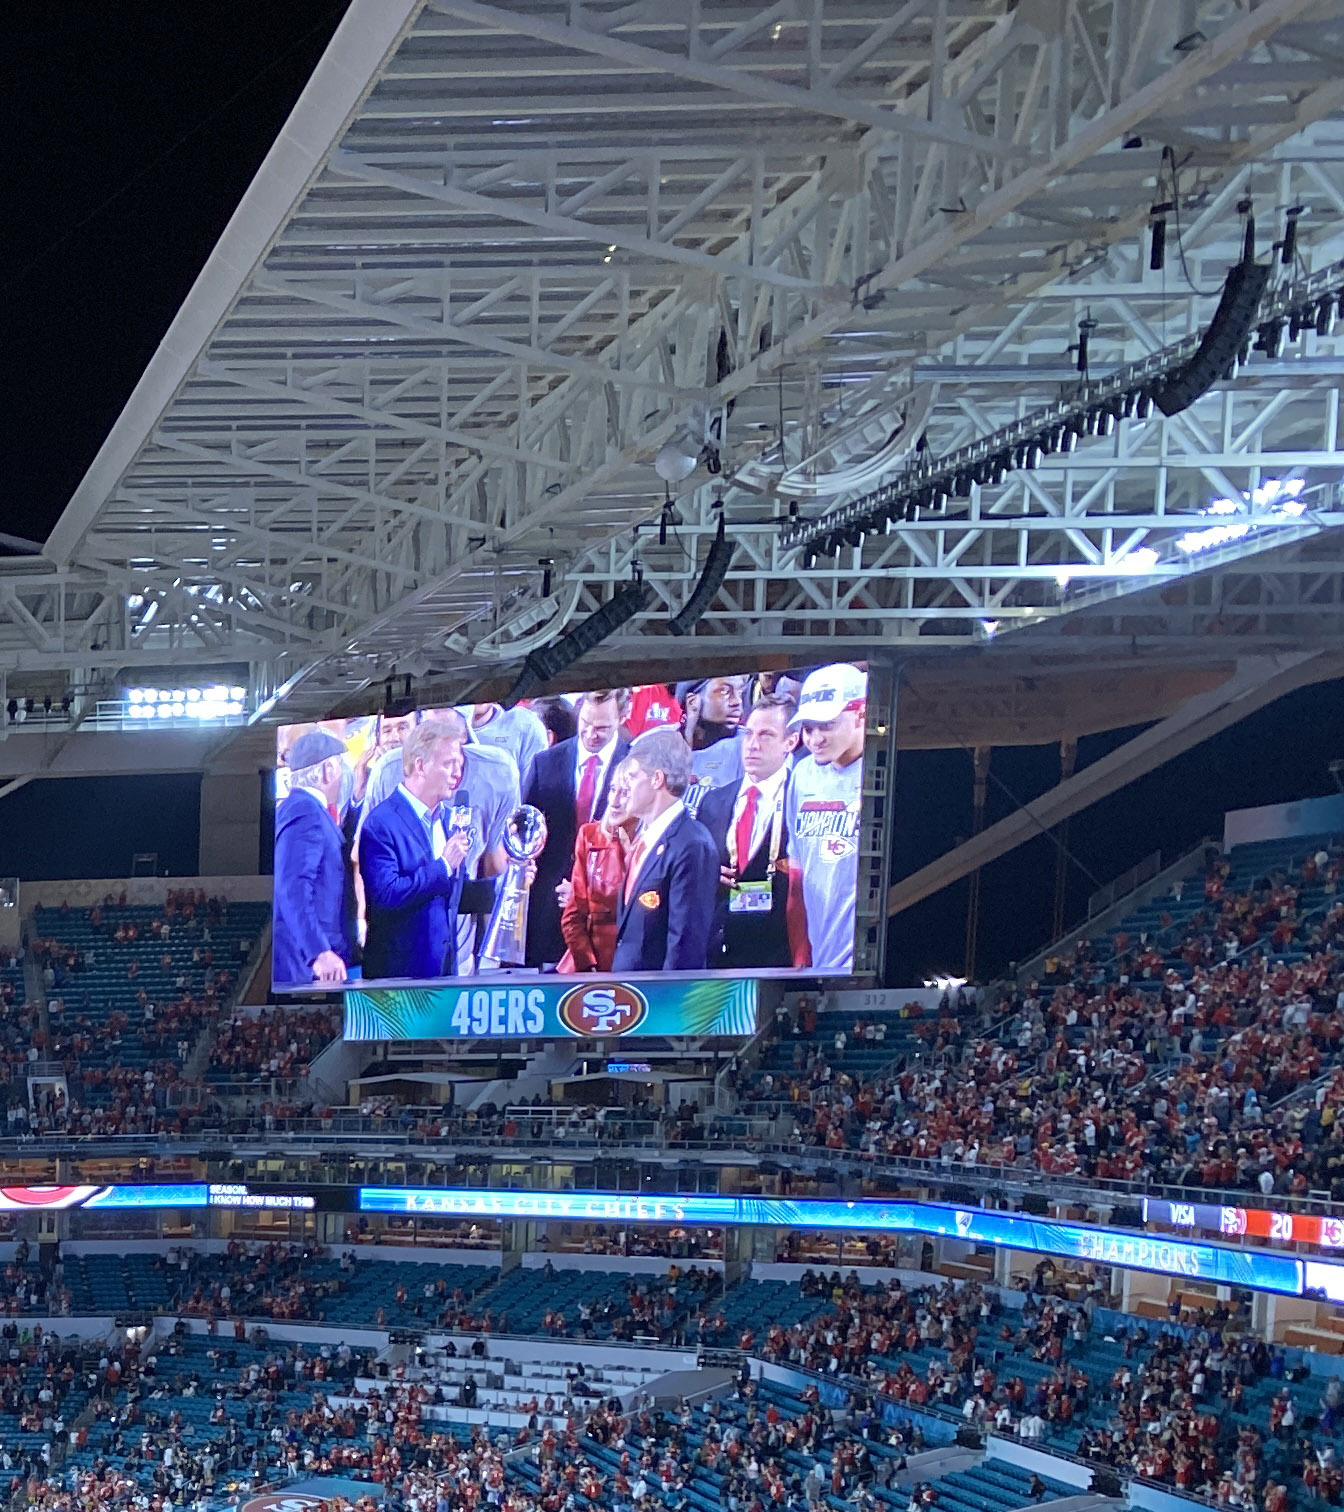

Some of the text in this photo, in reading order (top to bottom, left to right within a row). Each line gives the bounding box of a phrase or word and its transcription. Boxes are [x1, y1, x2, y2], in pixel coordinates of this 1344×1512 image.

[864, 994, 886, 1005] 312
[451, 988, 546, 1035] 49ERS
[215, 1195, 242, 1205] KNOW
[243, 1195, 265, 1205] HOW
[265, 1196, 292, 1207] MUCH
[514, 1199, 571, 1215] CITY
[585, 1201, 686, 1220] CHIEFS
[1170, 1203, 1195, 1226] VISA
[1271, 1214, 1293, 1240] 20
[1080, 1222, 1199, 1276] CHAMPIONS
